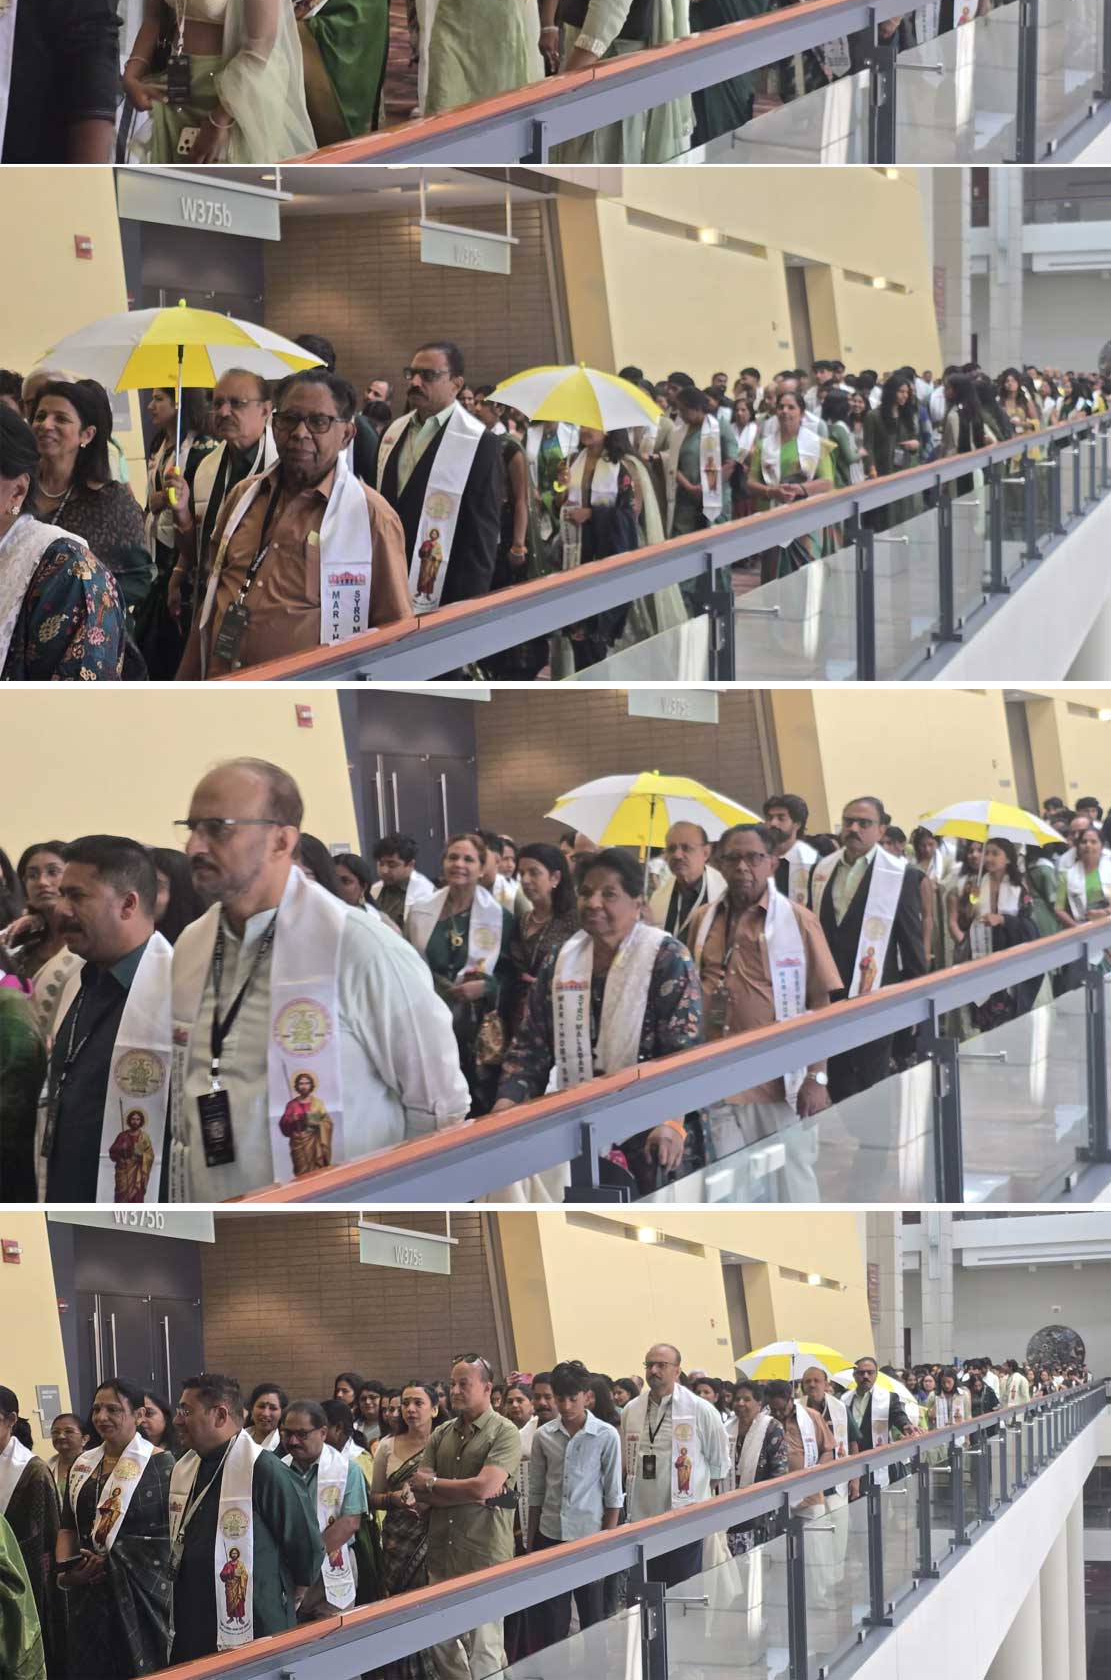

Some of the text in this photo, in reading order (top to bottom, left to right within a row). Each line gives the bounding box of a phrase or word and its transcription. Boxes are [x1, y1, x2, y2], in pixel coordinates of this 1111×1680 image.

[180, 197, 232, 227] W375b
[331, 590, 341, 618] MAR
[353, 590, 361, 623] SYRO
